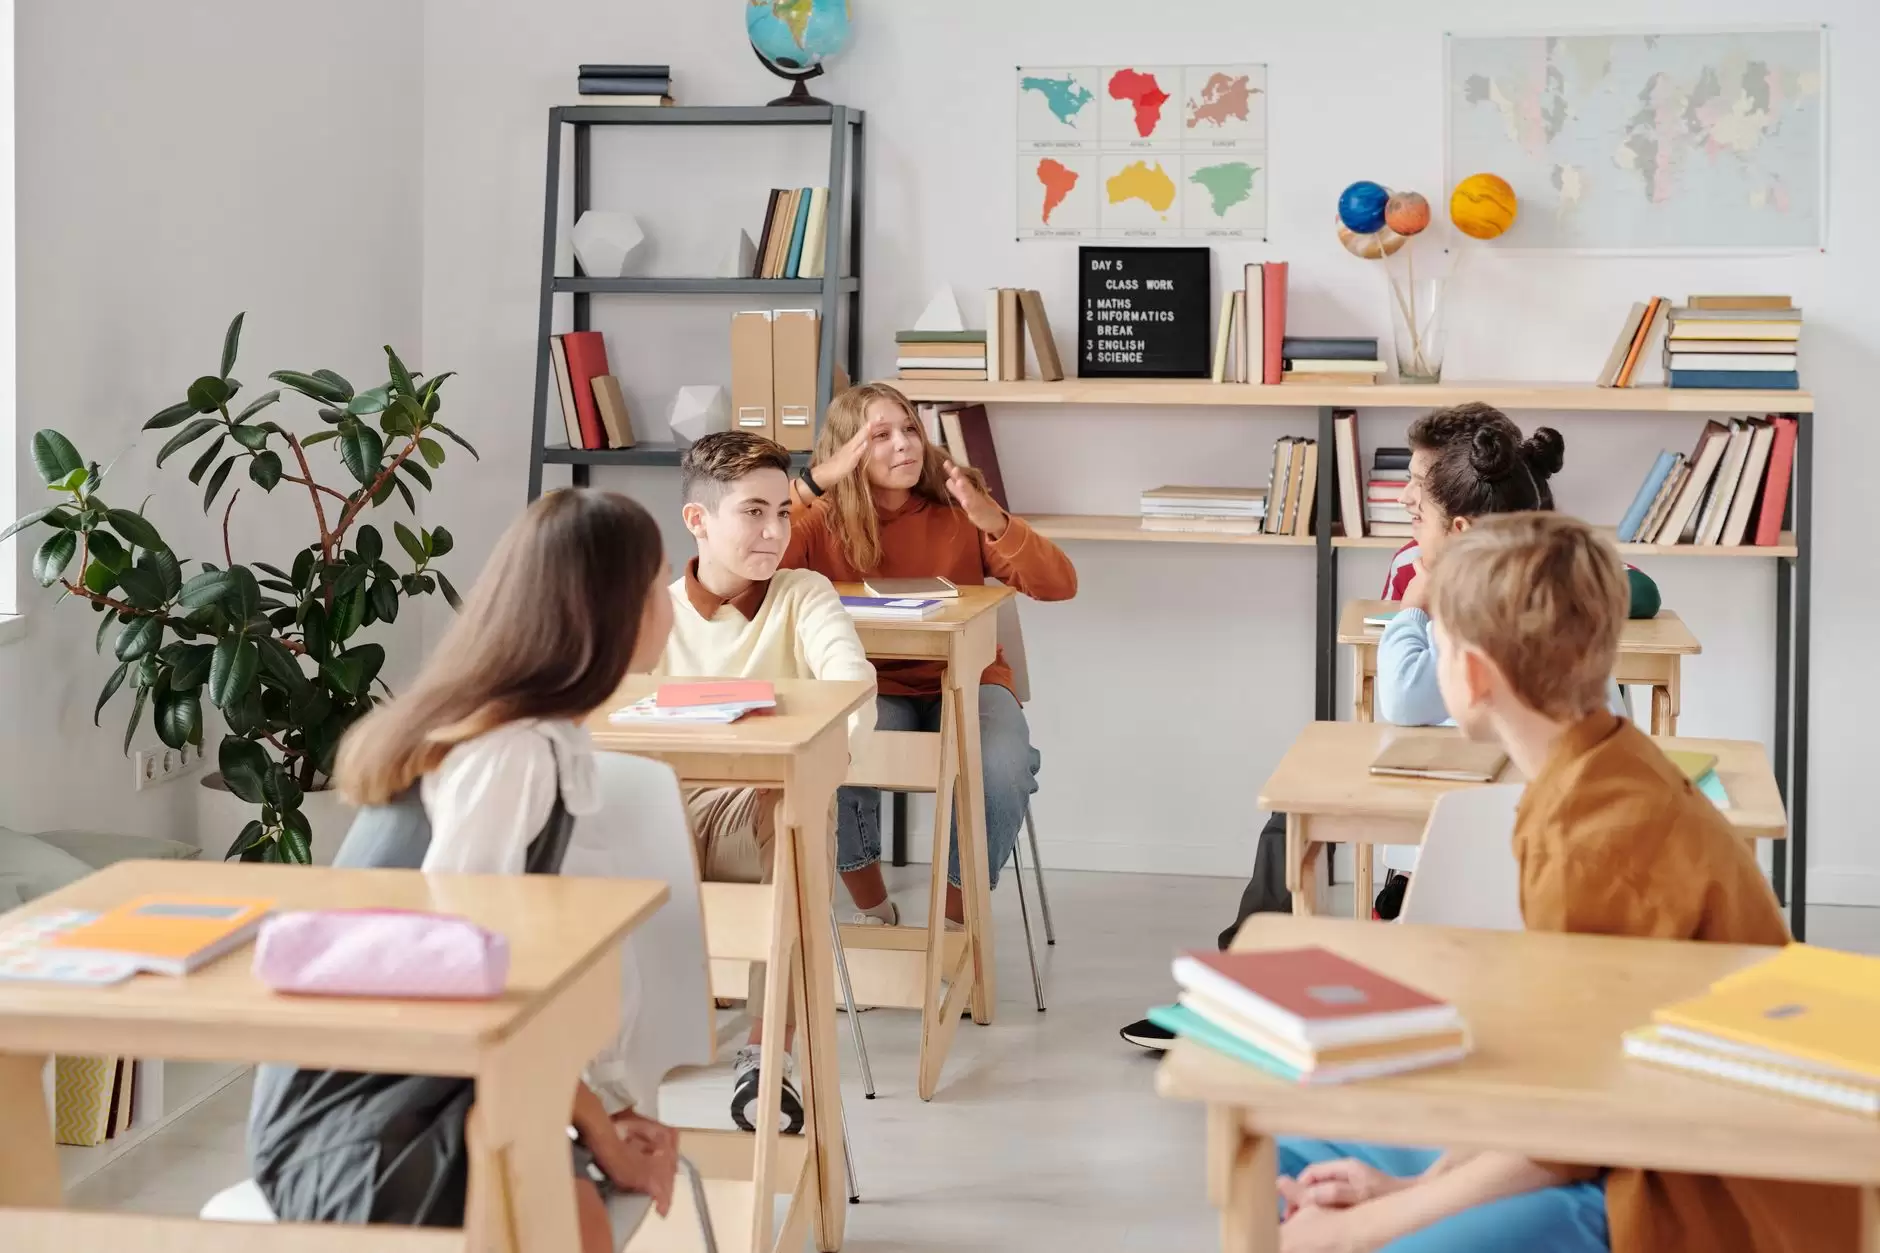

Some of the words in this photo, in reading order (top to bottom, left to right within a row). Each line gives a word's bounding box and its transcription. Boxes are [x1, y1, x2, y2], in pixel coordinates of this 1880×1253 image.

[1091, 260, 1112, 270] DAY
[1116, 260, 1123, 270] 5
[1105, 279, 1139, 290] CLASS
[1146, 279, 1174, 290] WORK
[1087, 299, 1092, 309] 1
[1097, 298, 1132, 309] MATHS
[1086, 311, 1094, 321] 2
[1097, 311, 1175, 321] INFORMATICS
[1097, 325, 1134, 335] BREAK
[1086, 340, 1093, 350] 3
[1098, 340, 1145, 350] ENGLISH
[1086, 352, 1093, 362] 4
[1097, 352, 1143, 362] SCIENCE
